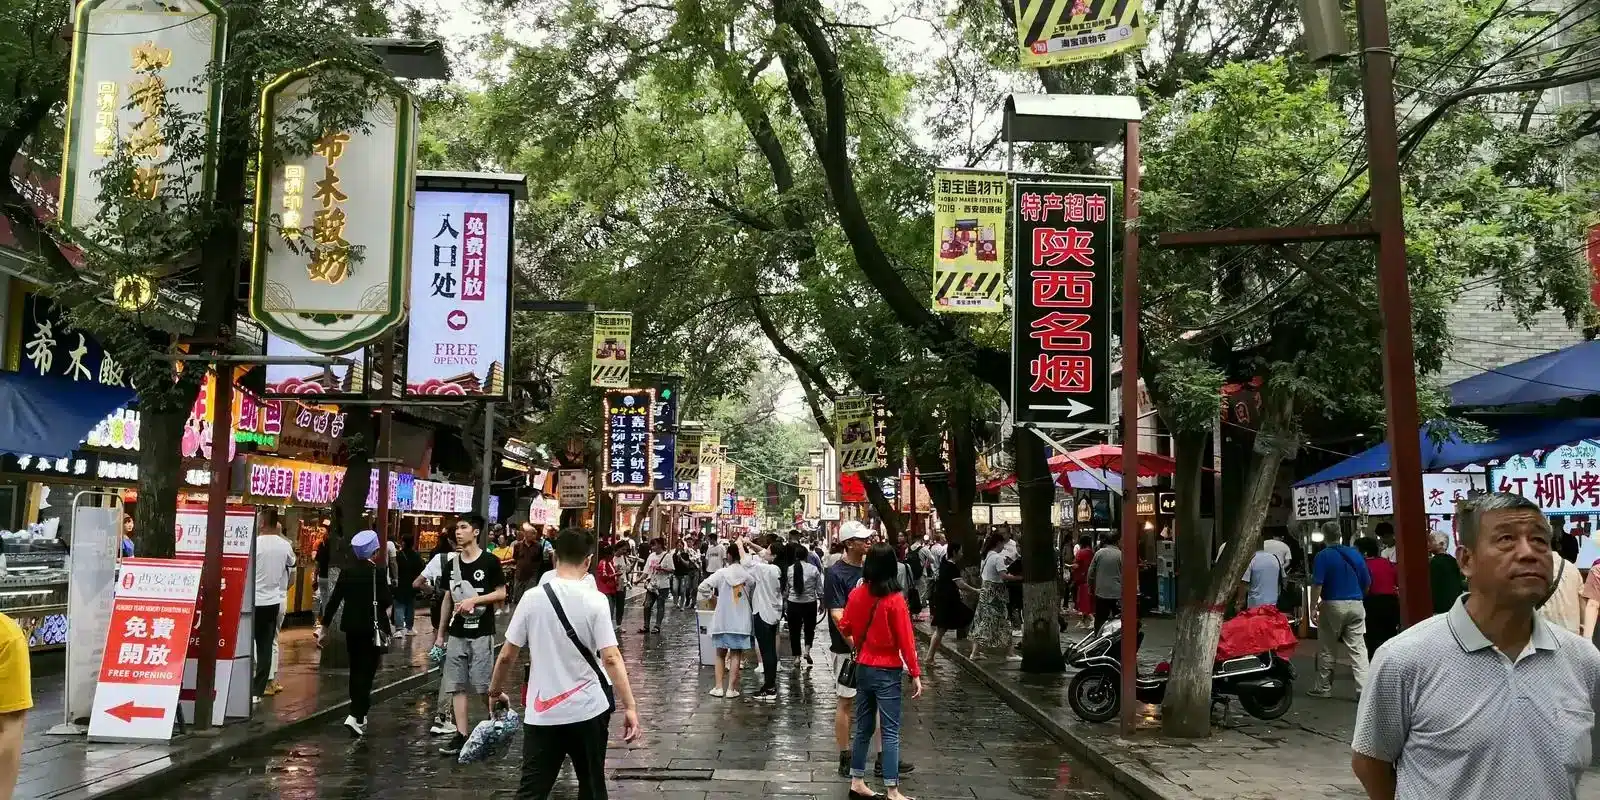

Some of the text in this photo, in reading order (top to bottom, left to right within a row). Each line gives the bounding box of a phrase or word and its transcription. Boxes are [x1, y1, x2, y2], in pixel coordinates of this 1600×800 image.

[1061, 33, 1106, 48] 淘宝造物节
[938, 179, 1004, 195] 淘宝造物节
[938, 204, 955, 213] 2019
[1021, 192, 1106, 222] 特产超市
[431, 213, 460, 298] 入口处
[463, 216, 485, 297] 免费开放
[1030, 227, 1095, 393] 陕西名烟
[433, 343, 478, 356] FREE
[433, 356, 478, 365] OPENING
[611, 415, 626, 484] 红柳烤羊肉
[1561, 458, 1597, 469] 老马家
[251, 464, 294, 497] 长沙臭豆腐
[1298, 496, 1330, 516] 老酸奶
[123, 615, 176, 640] 免費
[117, 642, 171, 666] 開放
[108, 669, 174, 680] FREE OPENING
